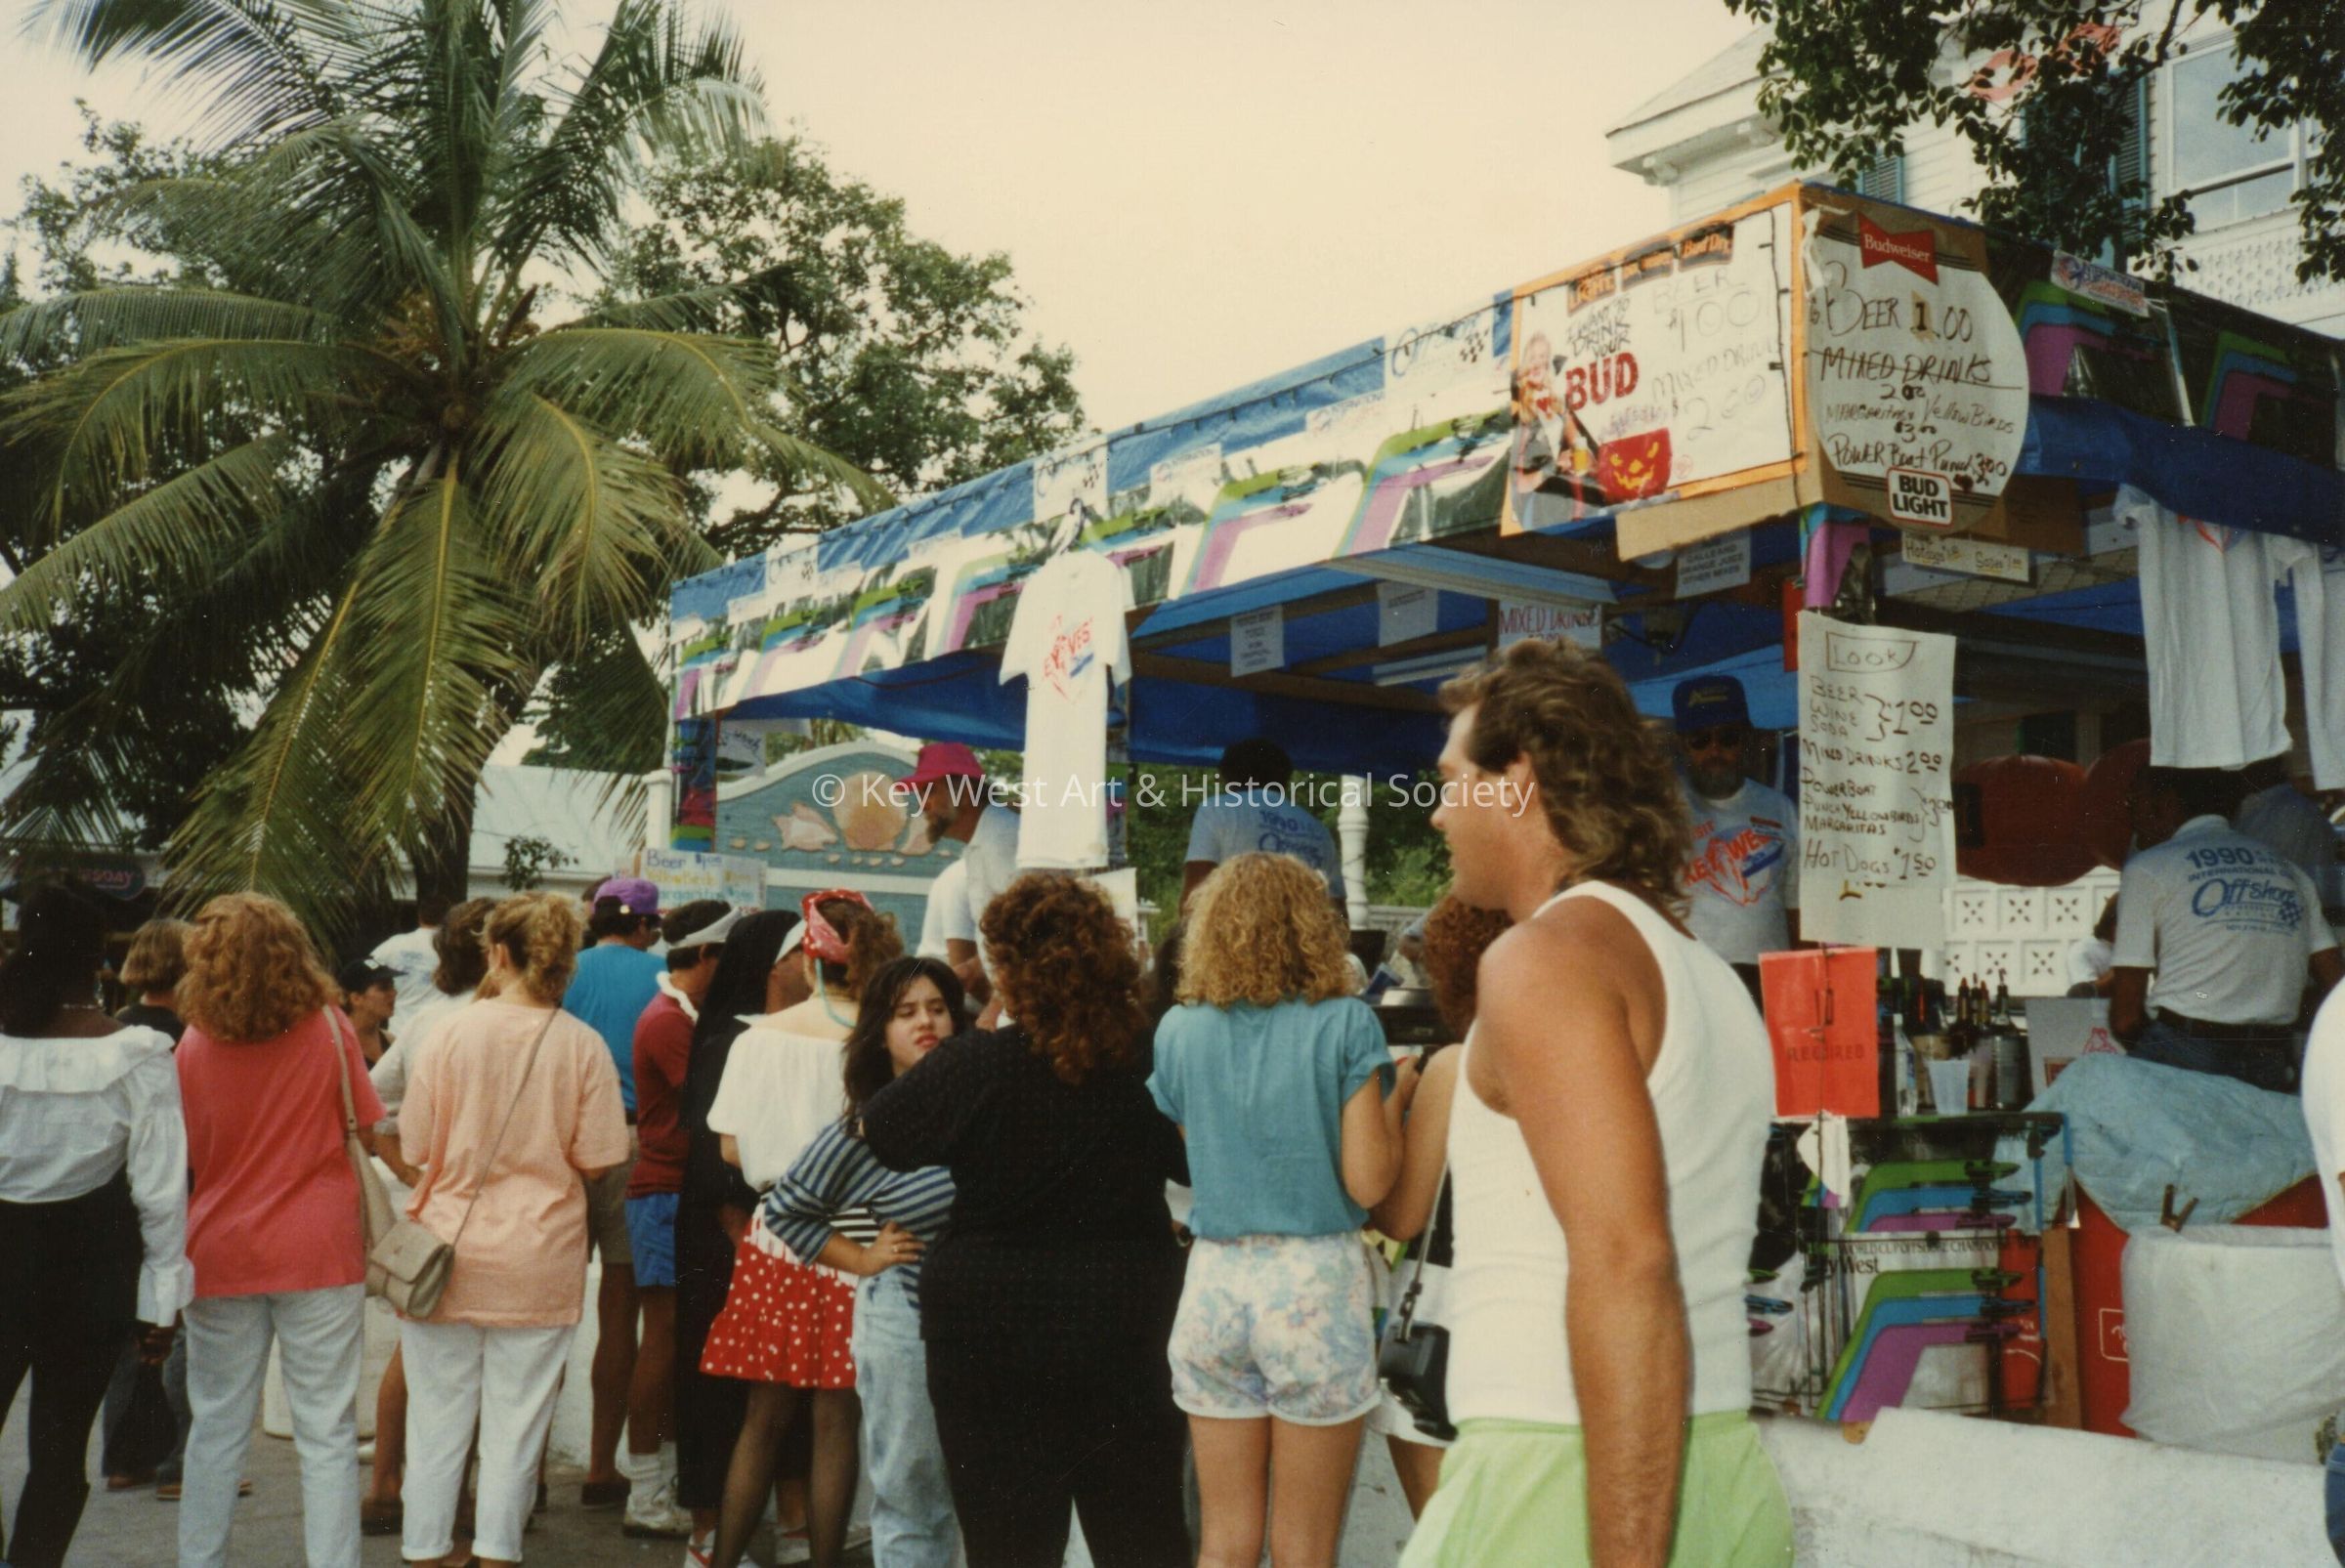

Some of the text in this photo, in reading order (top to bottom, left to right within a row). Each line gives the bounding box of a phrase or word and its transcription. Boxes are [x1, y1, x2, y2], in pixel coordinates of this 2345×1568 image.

[1863, 233, 1931, 264] Budweiser
[1820, 346, 1993, 385] MIXED DRINKS
[1565, 352, 1640, 411] BUD
[1827, 433, 1885, 468] POWER
[1898, 475, 1940, 497] BUD
[1893, 493, 1947, 518] LIGHT
[1845, 746, 1903, 772] DRINKS
[647, 848, 686, 869] Beer
[1804, 838, 1840, 869] HOT
[1844, 844, 1891, 874] DOGS
[2186, 847, 2255, 869] 1990
[2192, 878, 2297, 918] Offshore
[1838, 1254, 1880, 1276] West
